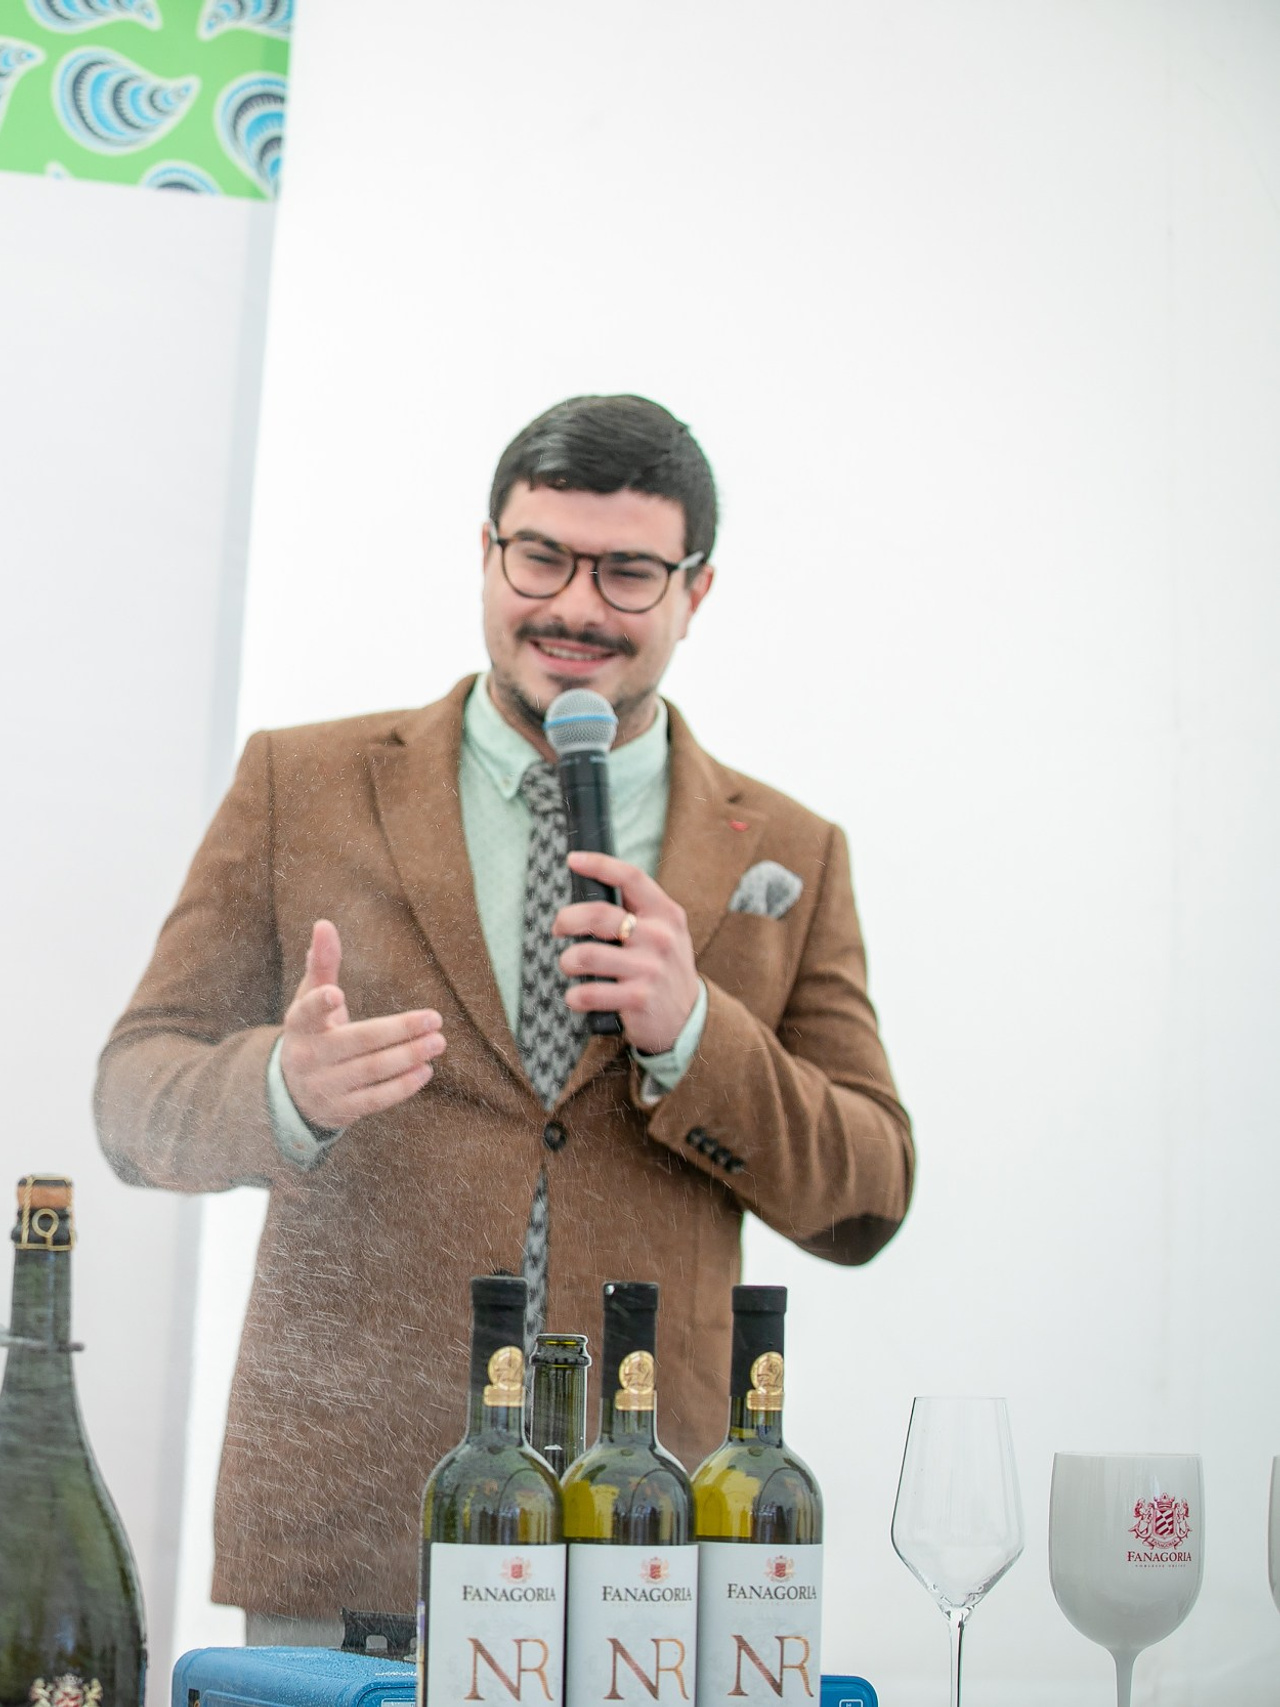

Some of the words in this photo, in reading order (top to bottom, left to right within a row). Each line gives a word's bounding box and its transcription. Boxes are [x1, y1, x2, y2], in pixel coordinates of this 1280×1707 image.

[1127, 1551, 1192, 1562] FANAGORIA
[462, 1585, 556, 1602] FANAGORIA
[602, 1585, 692, 1602] FANAGORIA
[727, 1583, 817, 1600] FANAGORIA
[463, 1637, 555, 1701] NR
[603, 1637, 690, 1701] NR
[727, 1634, 815, 1698] NR
